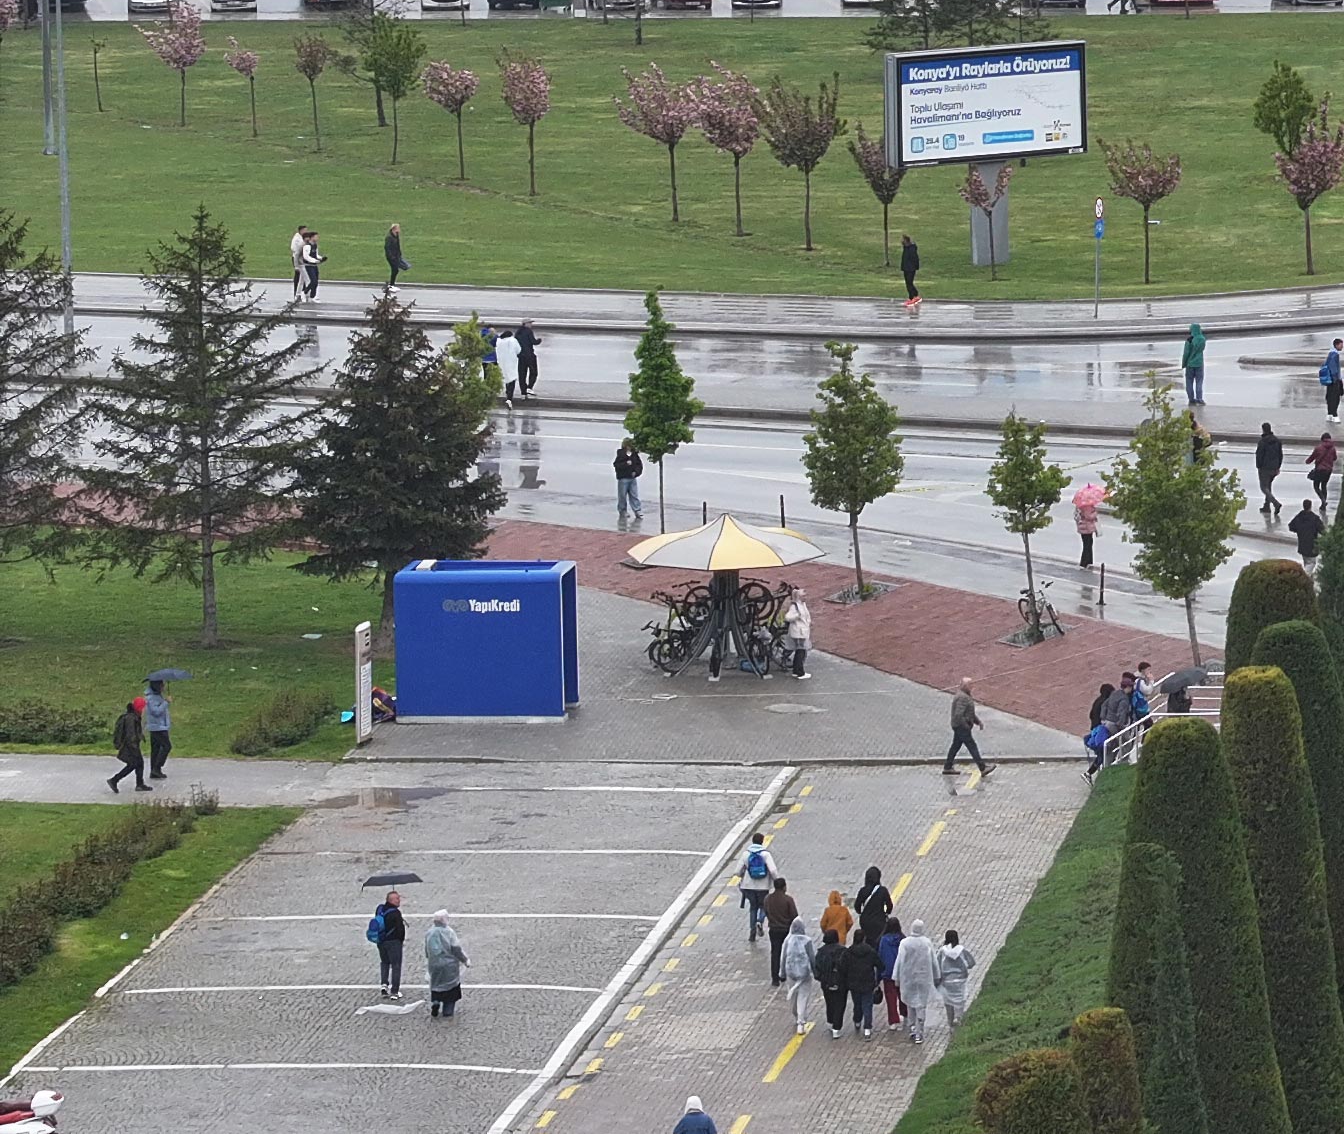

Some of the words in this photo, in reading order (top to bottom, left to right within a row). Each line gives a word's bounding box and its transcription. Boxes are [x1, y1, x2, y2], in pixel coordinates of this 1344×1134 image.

[909, 67, 960, 81] Konya'yı
[962, 60, 1012, 77] Raylarla
[1013, 56, 1070, 74] Örüyoruz!
[910, 87, 943, 96] Konyaray
[910, 102, 932, 114] Toplu
[934, 102, 964, 111] Ulaşımı
[910, 112, 973, 124] Havalimanı'na
[974, 108, 1022, 120] Bağlıyoruz
[469, 599, 520, 614] YapıKredi
